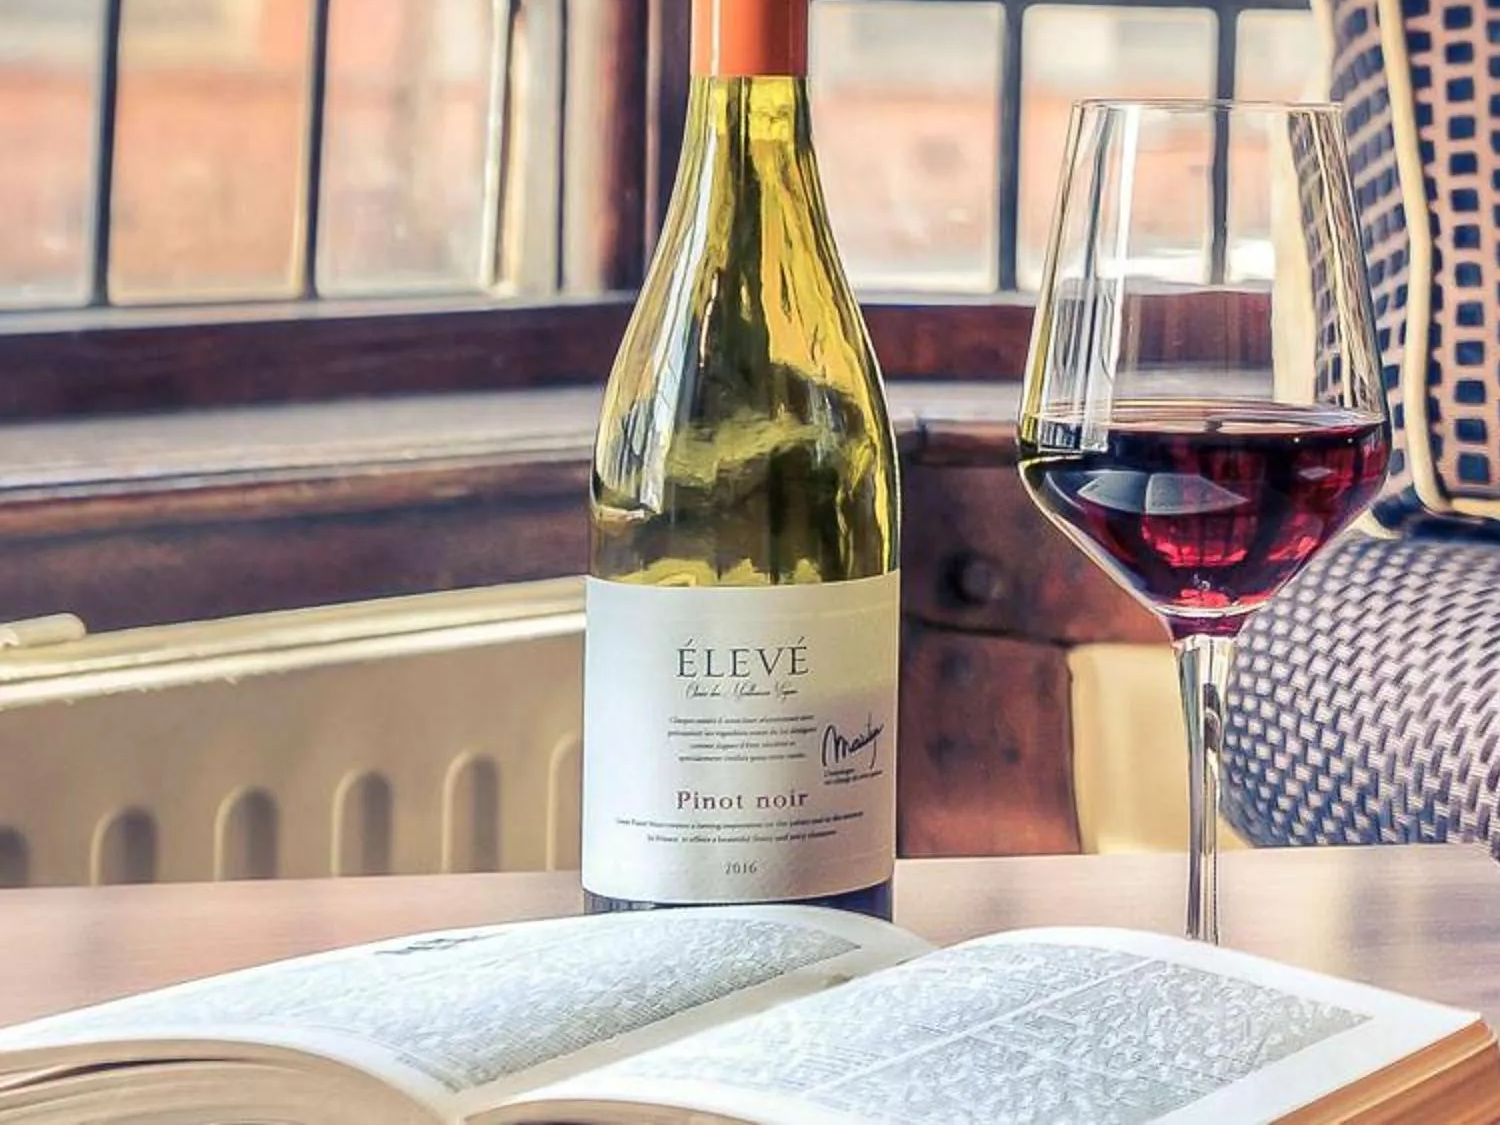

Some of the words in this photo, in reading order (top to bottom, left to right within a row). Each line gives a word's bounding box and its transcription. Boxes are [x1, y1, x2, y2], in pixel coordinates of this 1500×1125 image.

[676, 636, 809, 677] ÉLEVÉ
[677, 789, 743, 810] Pinot
[756, 789, 809, 809] noir
[724, 860, 758, 875] 2016
